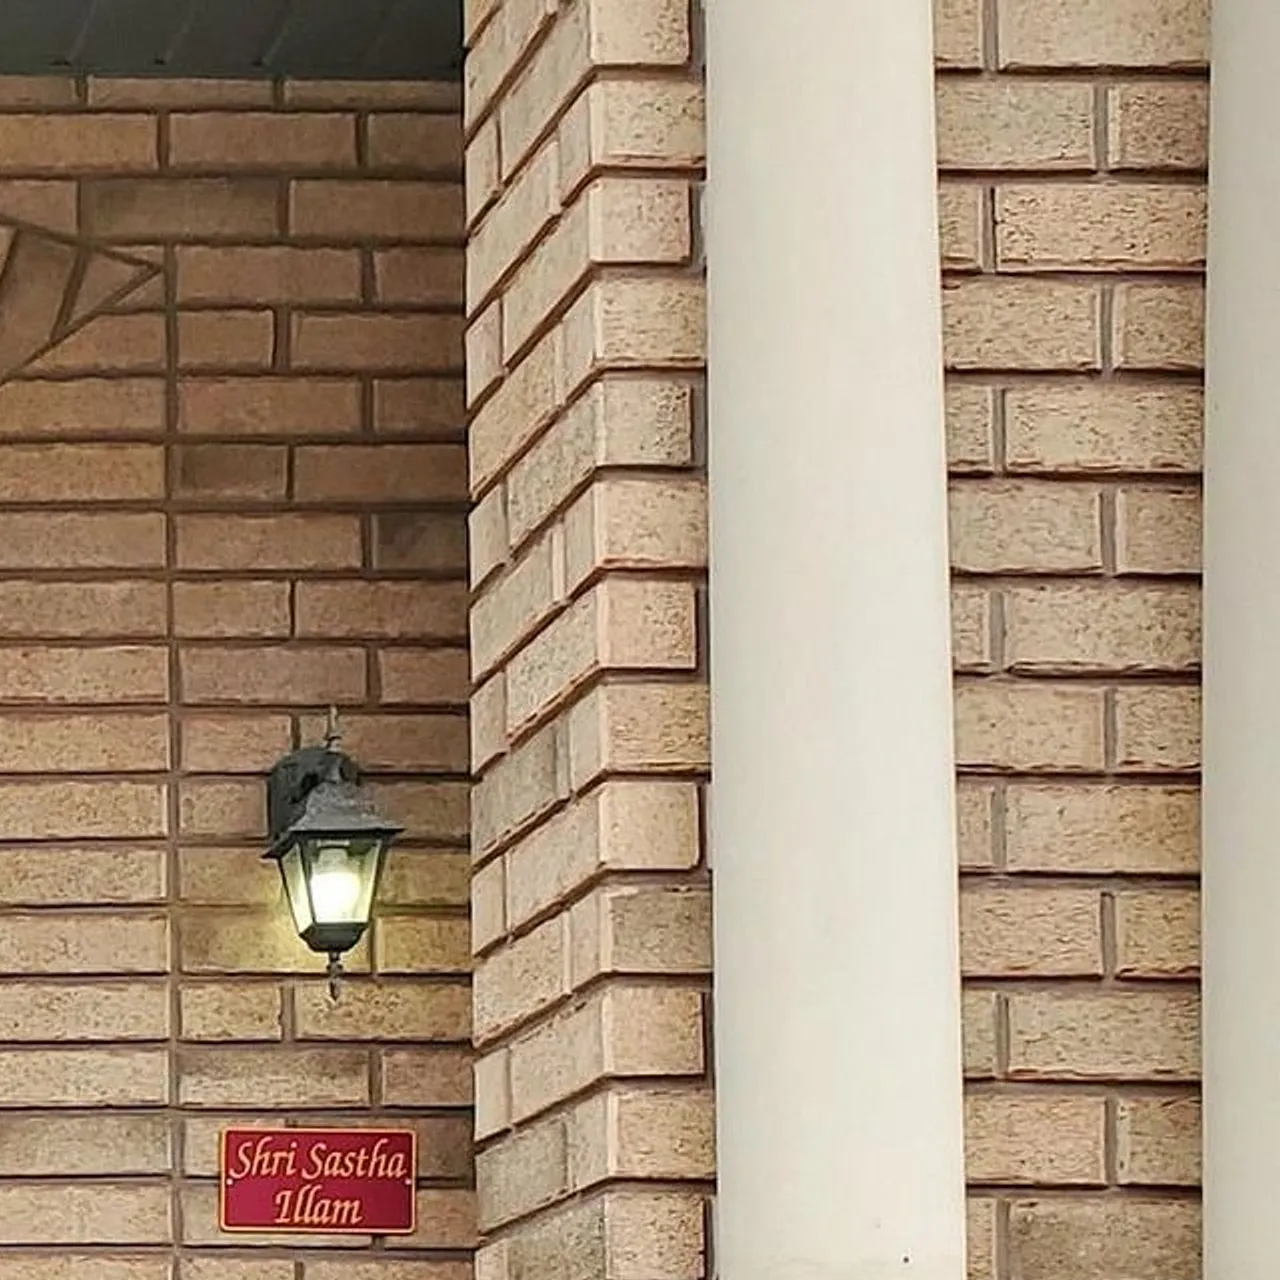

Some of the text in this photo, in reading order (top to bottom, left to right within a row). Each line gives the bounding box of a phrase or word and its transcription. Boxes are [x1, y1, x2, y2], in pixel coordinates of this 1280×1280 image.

[229, 1136, 407, 1180] Shri Sastha
[274, 1184, 362, 1225] Illam
